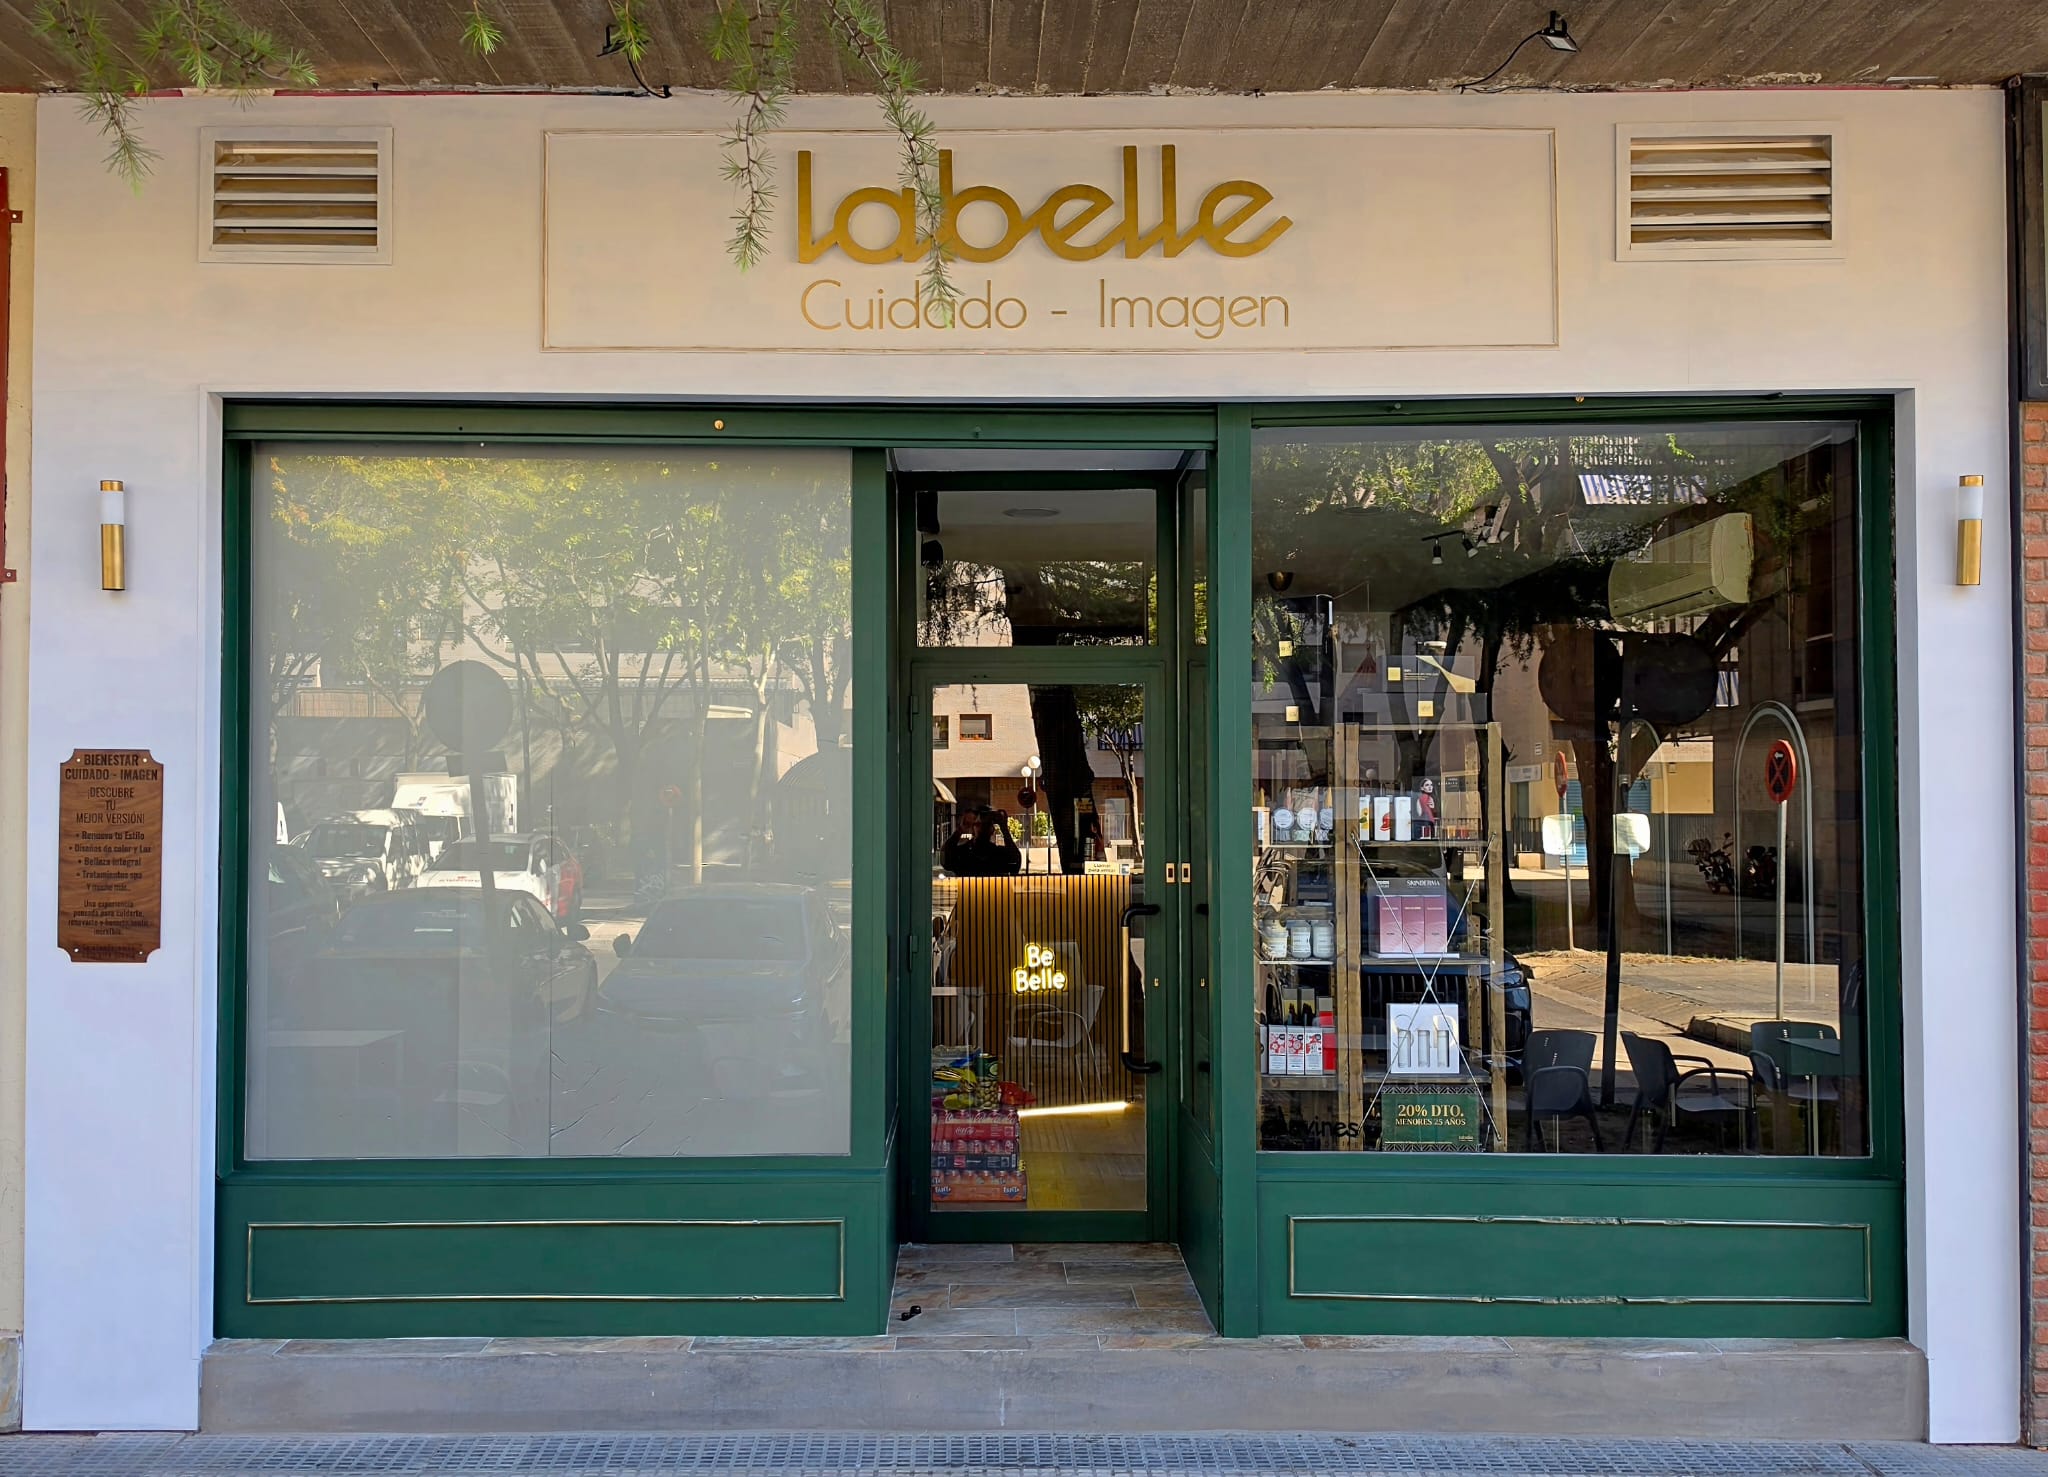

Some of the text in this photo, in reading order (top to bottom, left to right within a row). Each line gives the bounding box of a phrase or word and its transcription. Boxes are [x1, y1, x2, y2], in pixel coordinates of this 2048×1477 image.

[797, 144, 1294, 265] labelle
[800, 279, 1028, 331] Cuidado
[1099, 278, 1290, 340] Imagen
[84, 754, 139, 767] BIENESTAR
[65, 768, 110, 781] CUIDADO
[120, 769, 158, 781] IMAGEN
[87, 786, 135, 799] ¡DESCUBRE
[105, 799, 116, 811] TU
[76, 812, 103, 824] MEJOR
[124, 831, 145, 841] Estilo
[84, 857, 110, 866] Belleza
[1025, 944, 1054, 968] Be
[1014, 968, 1067, 992] Belle
[1398, 1104, 1464, 1117] 20% DTO.
[1395, 1116, 1466, 1126] MENORES 25 AÑOS
